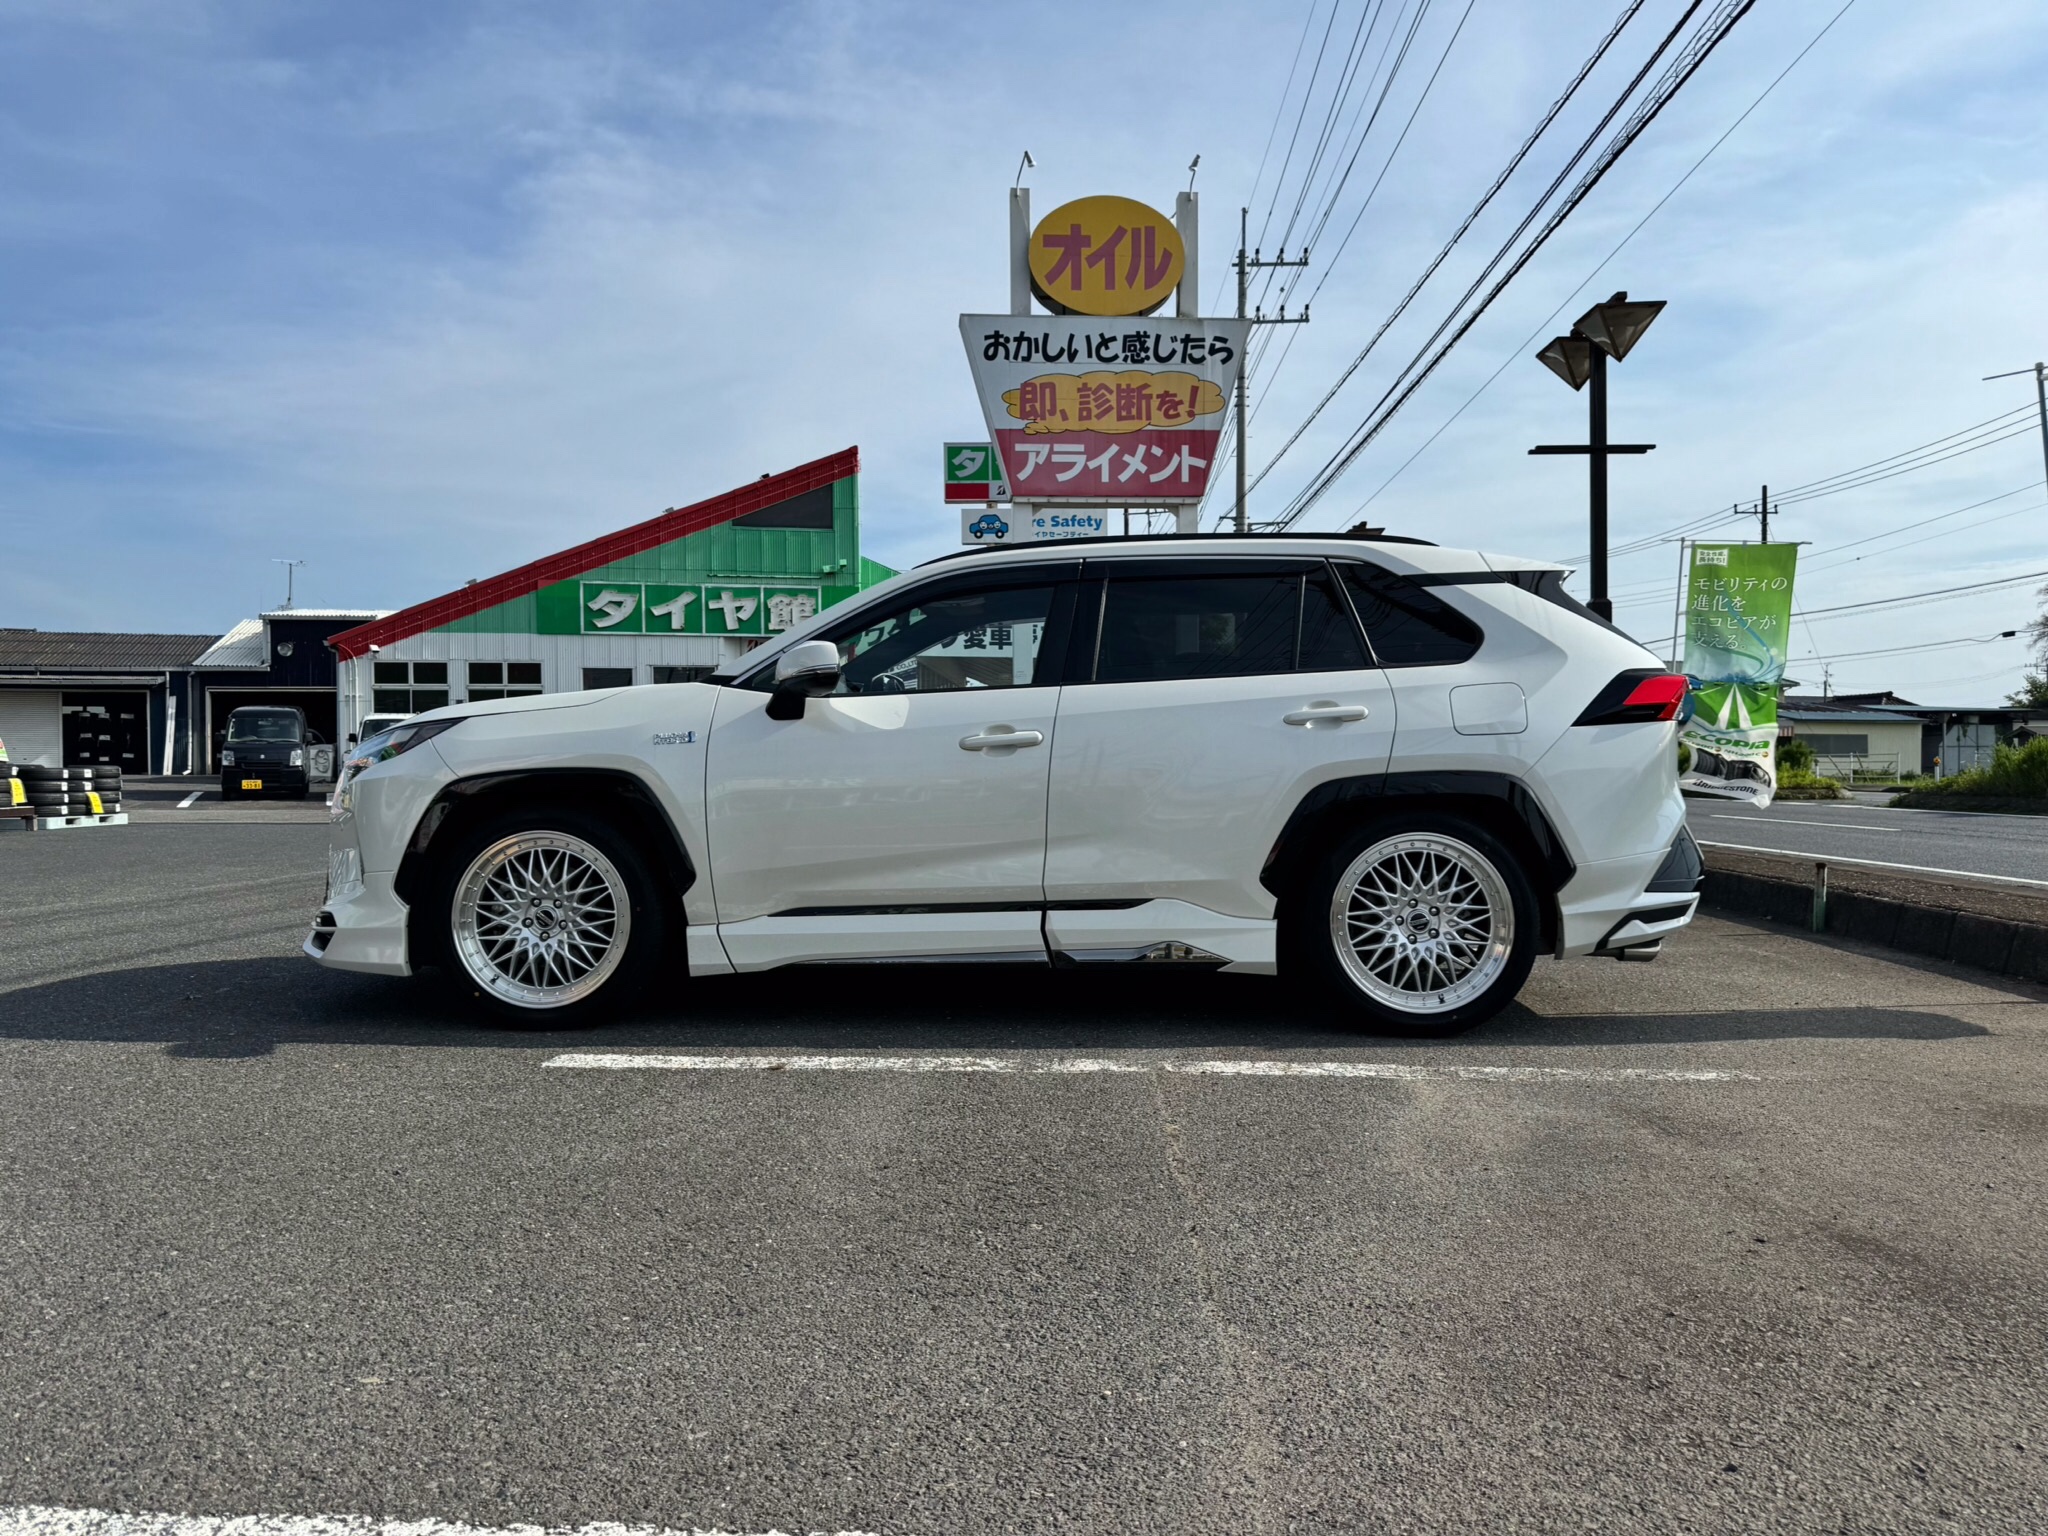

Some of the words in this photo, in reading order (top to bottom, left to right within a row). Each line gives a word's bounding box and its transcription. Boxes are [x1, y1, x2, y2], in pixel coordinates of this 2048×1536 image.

[1042, 223, 1174, 291] オイル
[983, 330, 1235, 366] おかしいと感じたら
[1014, 443, 1208, 484] アライメント
[1050, 514, 1103, 531] Safety
[1693, 576, 1788, 593] モビリティの
[586, 589, 817, 631] タイヤ館
[1691, 594, 1747, 612] 進化を
[1691, 614, 1777, 631] エコピアが
